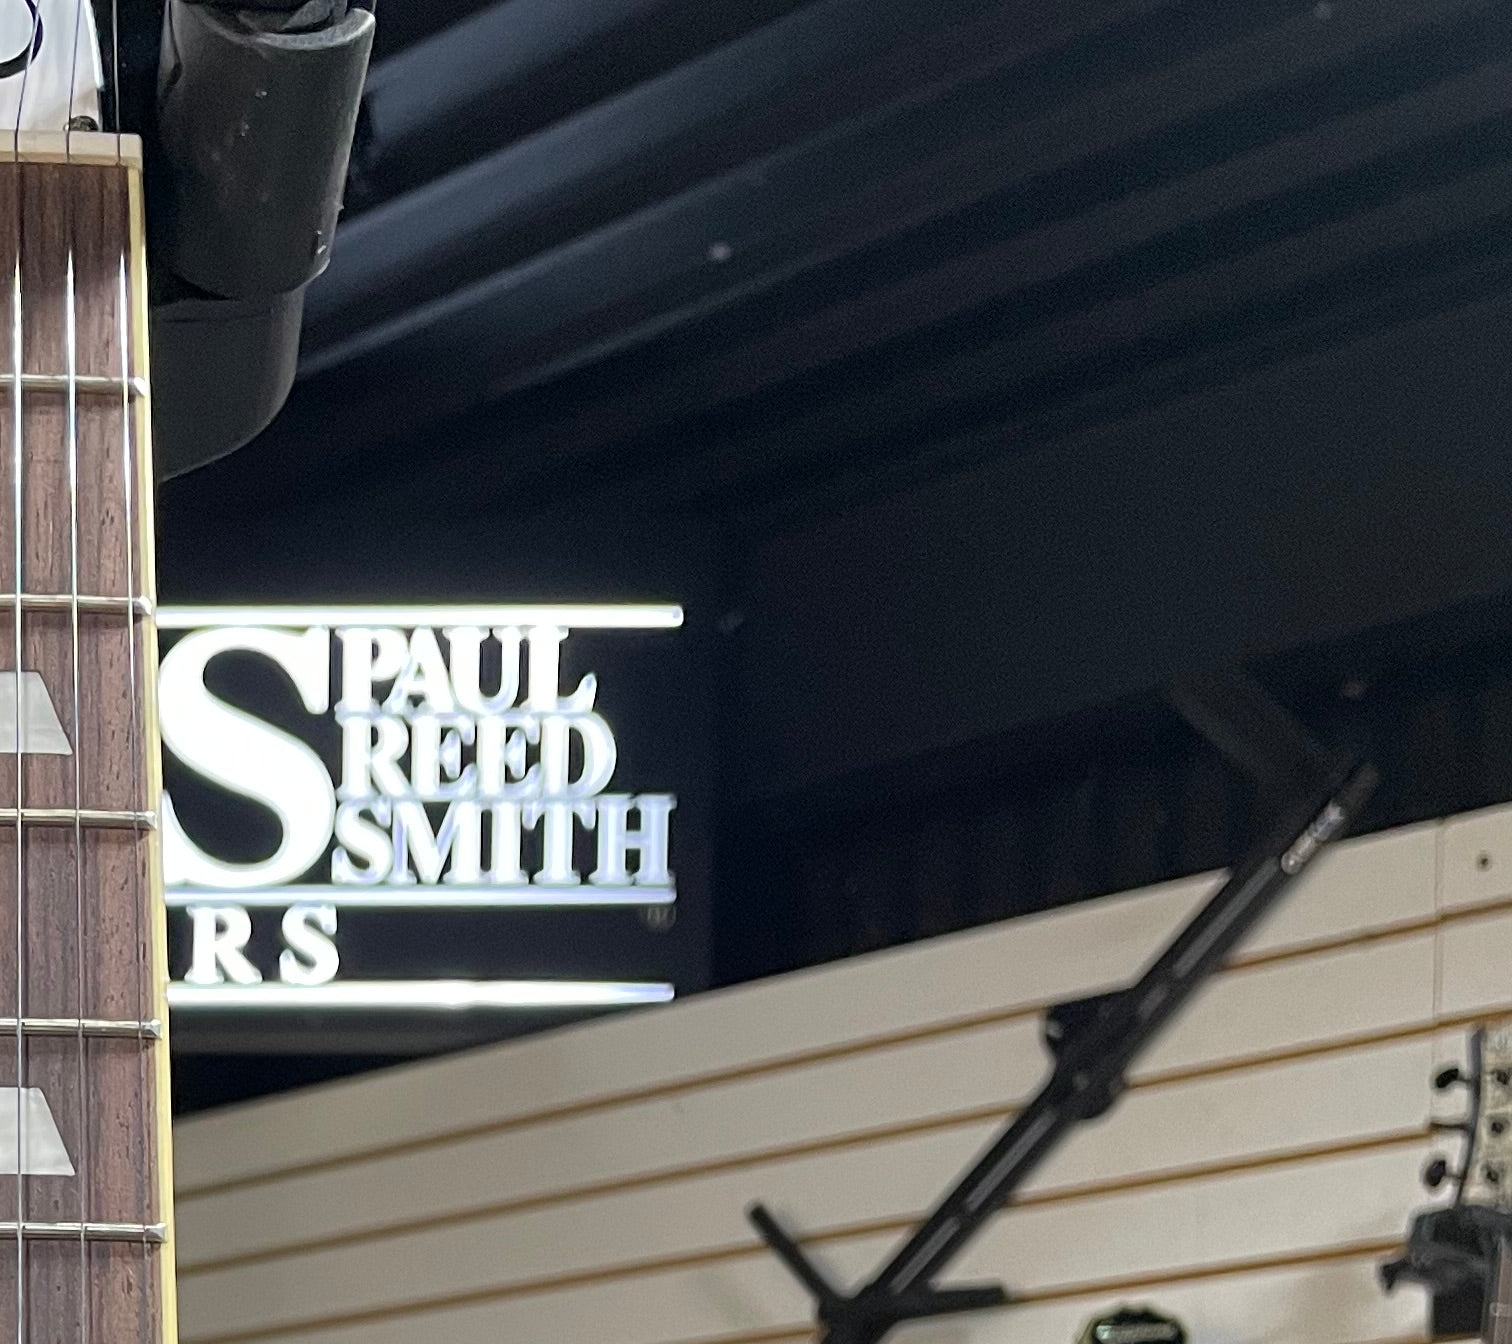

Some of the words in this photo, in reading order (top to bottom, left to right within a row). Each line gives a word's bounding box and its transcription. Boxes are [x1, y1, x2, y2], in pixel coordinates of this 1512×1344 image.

[335, 625, 597, 713] PAUL
[334, 712, 617, 800] REED
[331, 795, 677, 886] SMITH
